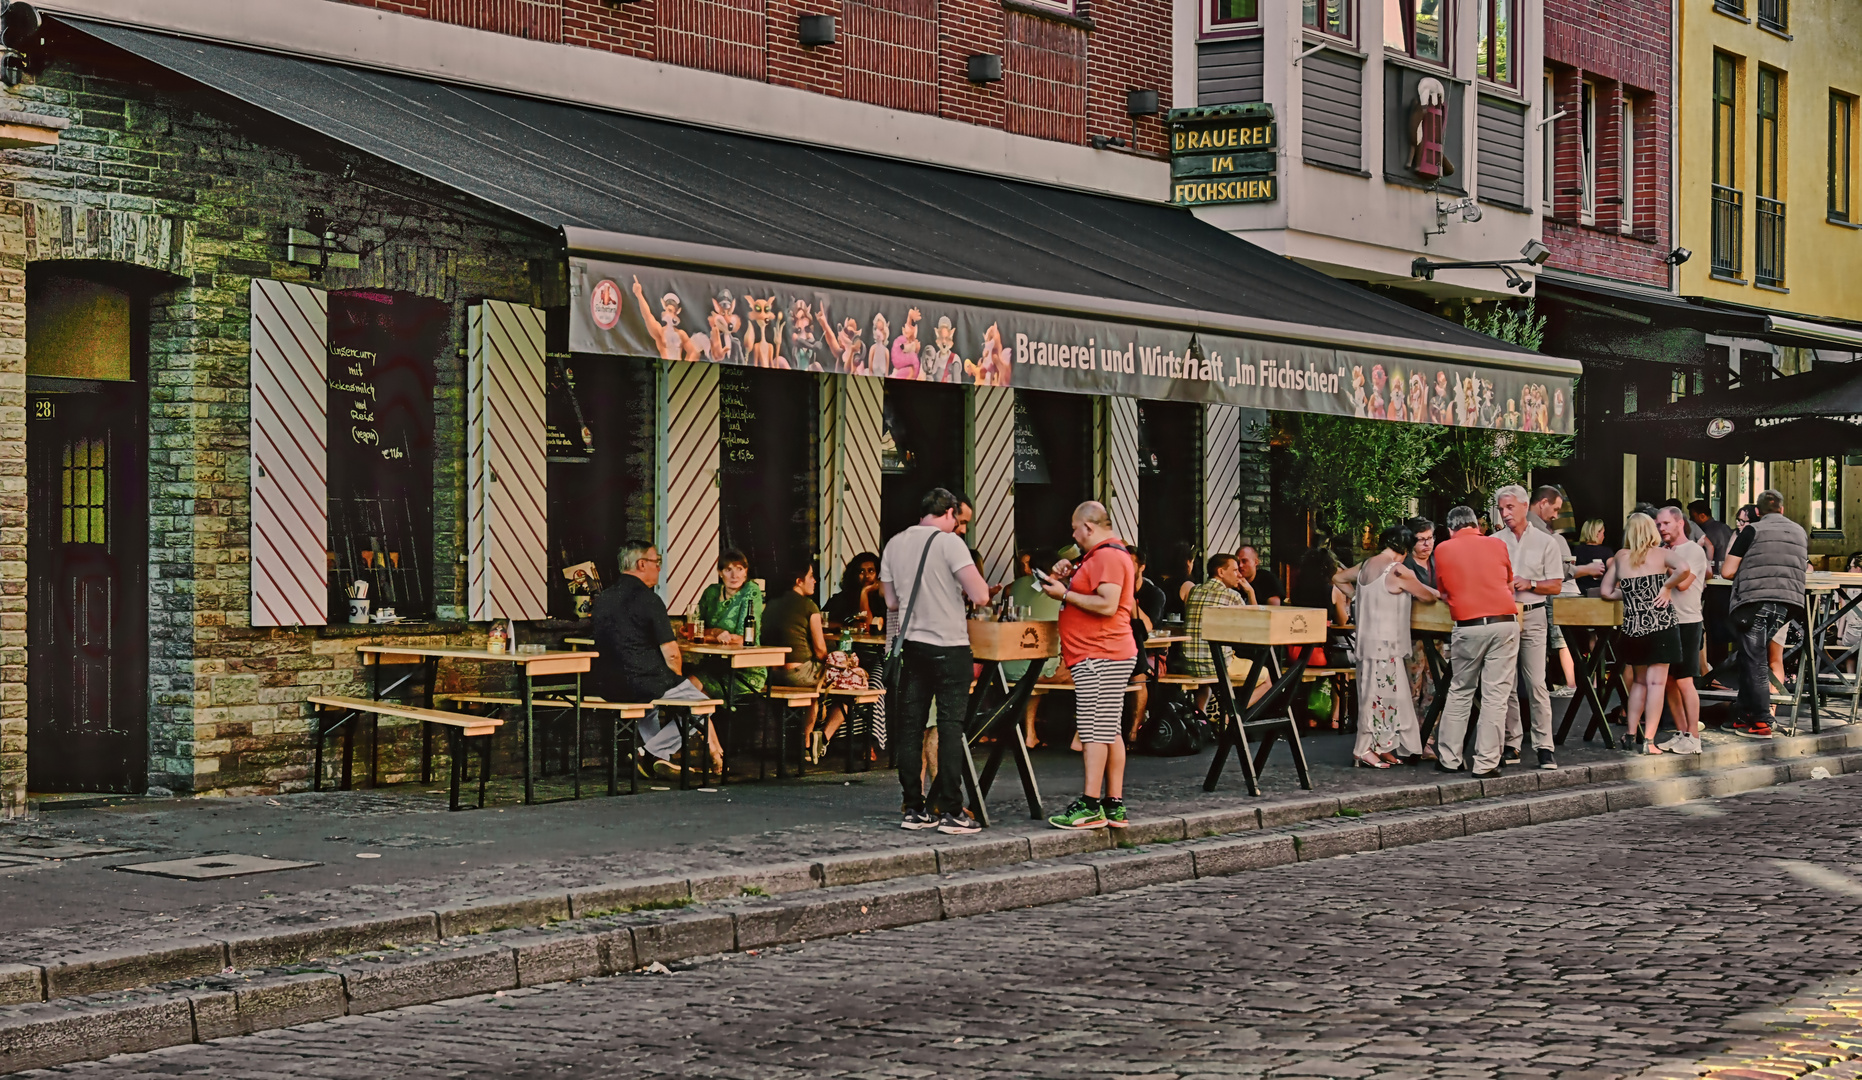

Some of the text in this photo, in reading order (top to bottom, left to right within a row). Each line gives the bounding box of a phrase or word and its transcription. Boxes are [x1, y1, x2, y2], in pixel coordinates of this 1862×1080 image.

[1175, 126, 1271, 150] BRAUEREI
[1212, 157, 1234, 172] IM
[1175, 180, 1272, 203] FÜCHSCHEN
[348, 362, 364, 377] mit
[1016, 332, 1096, 370] Brauerei
[1101, 342, 1135, 374] und
[1228, 356, 1256, 388] „Im
[1260, 359, 1346, 394] Füchschen“
[328, 378, 377, 402] Kokosmilch
[36, 401, 52, 418] 28
[354, 399, 368, 411] und
[350, 410, 375, 422] Reis
[351, 426, 380, 446] (vegan)
[729, 449, 755, 462] € 15,80
